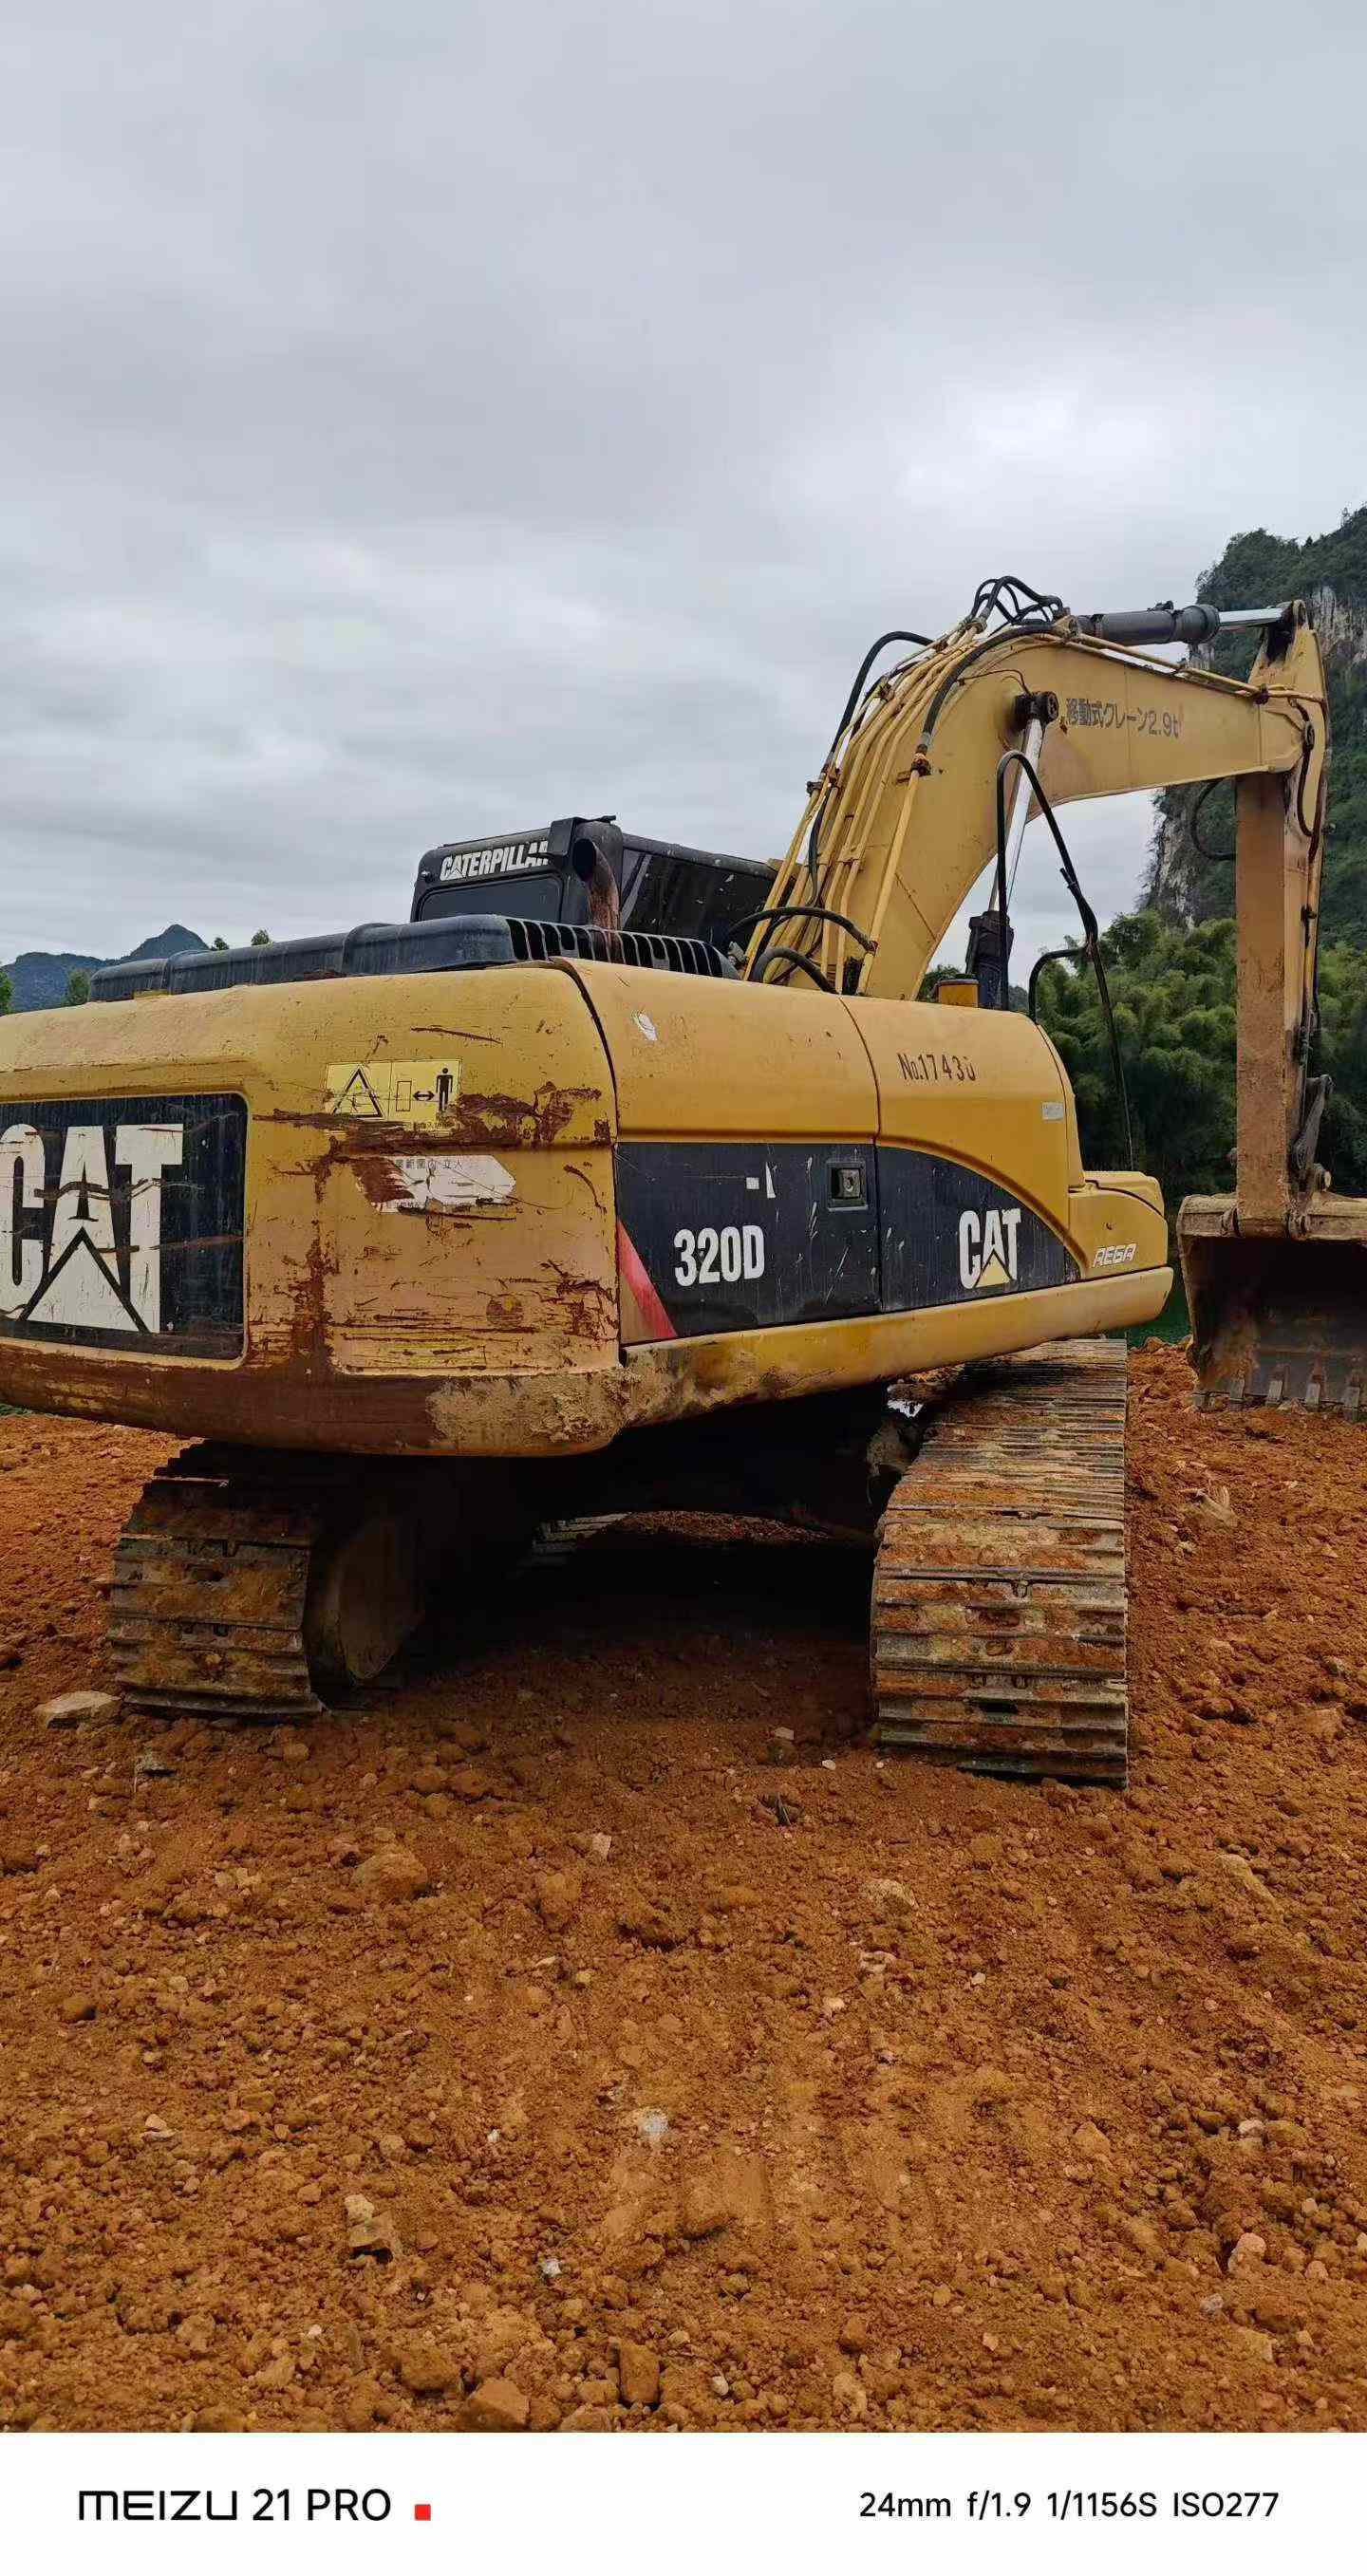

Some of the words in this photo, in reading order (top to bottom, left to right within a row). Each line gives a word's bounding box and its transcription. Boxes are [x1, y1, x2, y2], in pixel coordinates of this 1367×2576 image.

[0, 1123, 184, 1335] CAT
[673, 1224, 765, 1287] 320D
[959, 1207, 1021, 1290] CAT
